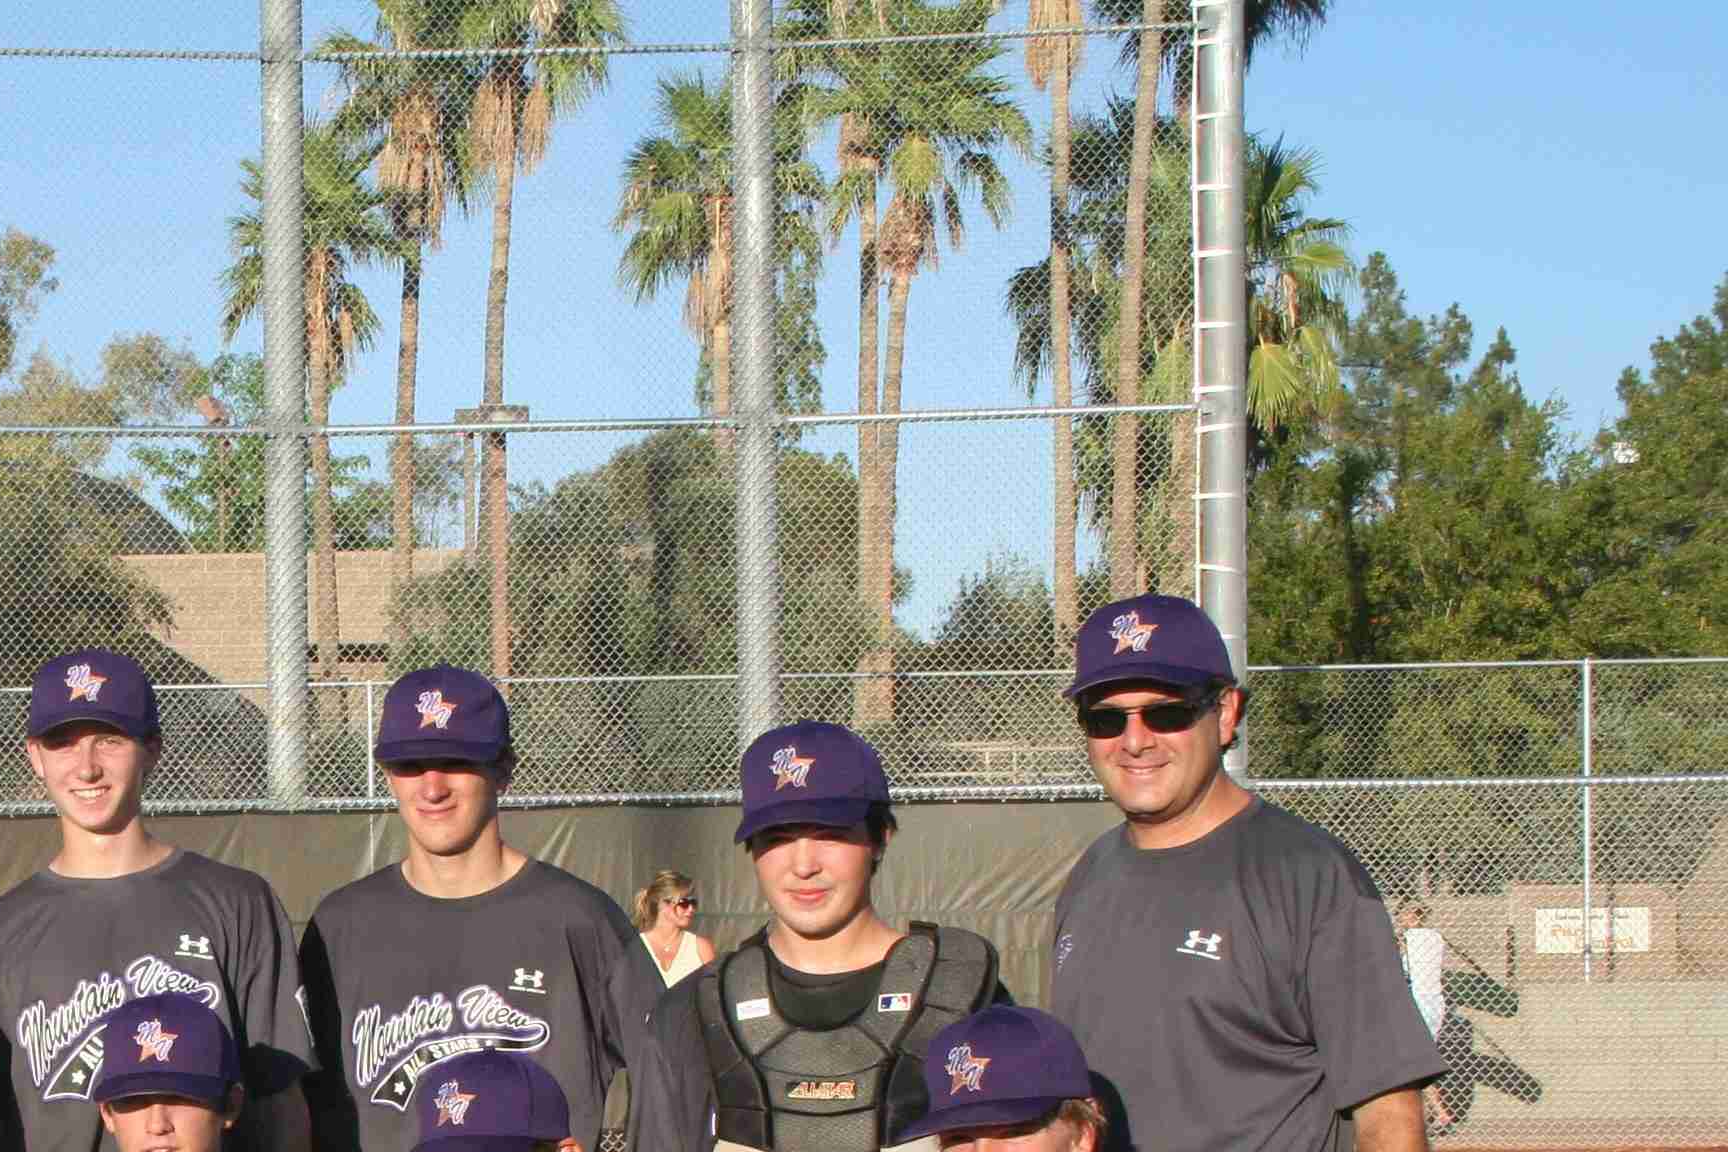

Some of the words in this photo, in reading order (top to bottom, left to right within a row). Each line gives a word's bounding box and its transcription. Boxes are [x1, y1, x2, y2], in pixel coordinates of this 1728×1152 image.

[19, 973, 125, 1086] Mountain
[127, 956, 200, 997] View
[353, 994, 452, 1086] Mountain
[459, 985, 531, 1028] View
